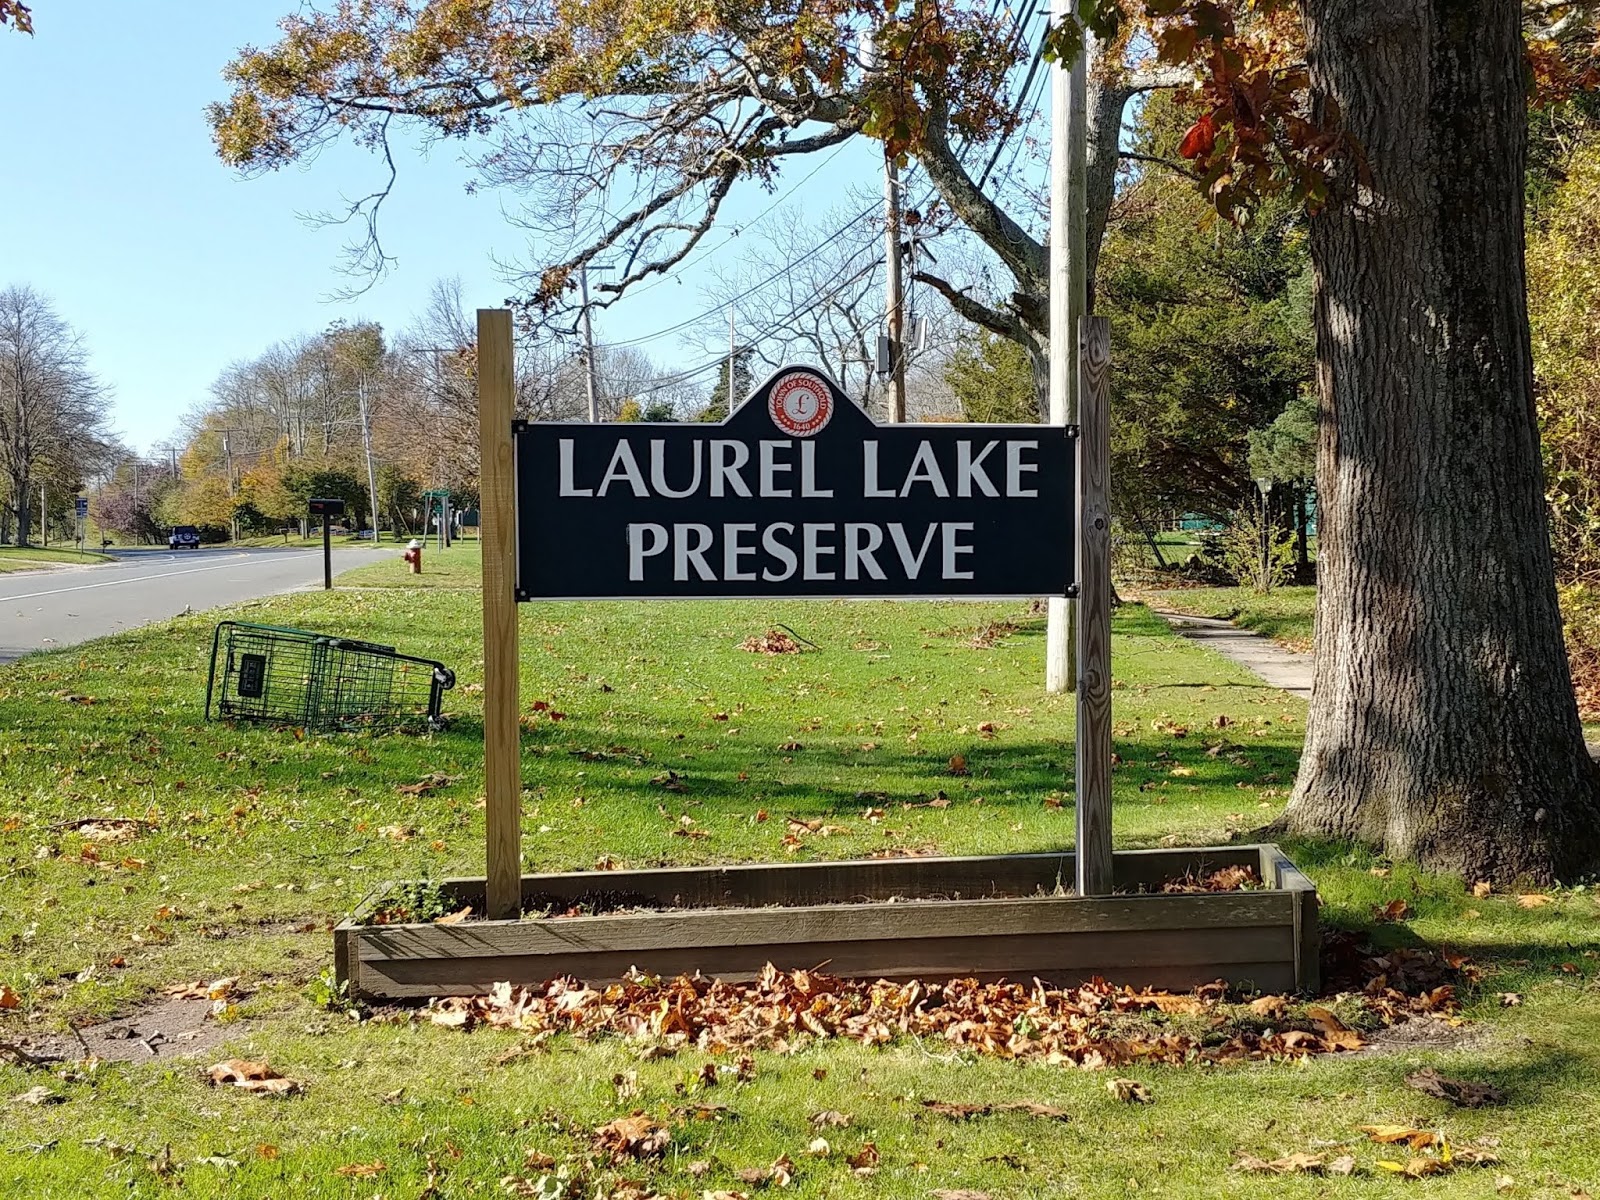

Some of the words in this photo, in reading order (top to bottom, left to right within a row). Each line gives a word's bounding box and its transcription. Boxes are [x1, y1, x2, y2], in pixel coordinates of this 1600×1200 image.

[776, 387, 788, 408] TOWN
[787, 380, 798, 389] OF
[798, 379, 827, 409] SOUTHOLD
[559, 439, 834, 498] LAUREL
[863, 440, 1039, 498] LAKE
[628, 522, 975, 582] PRESERVE
